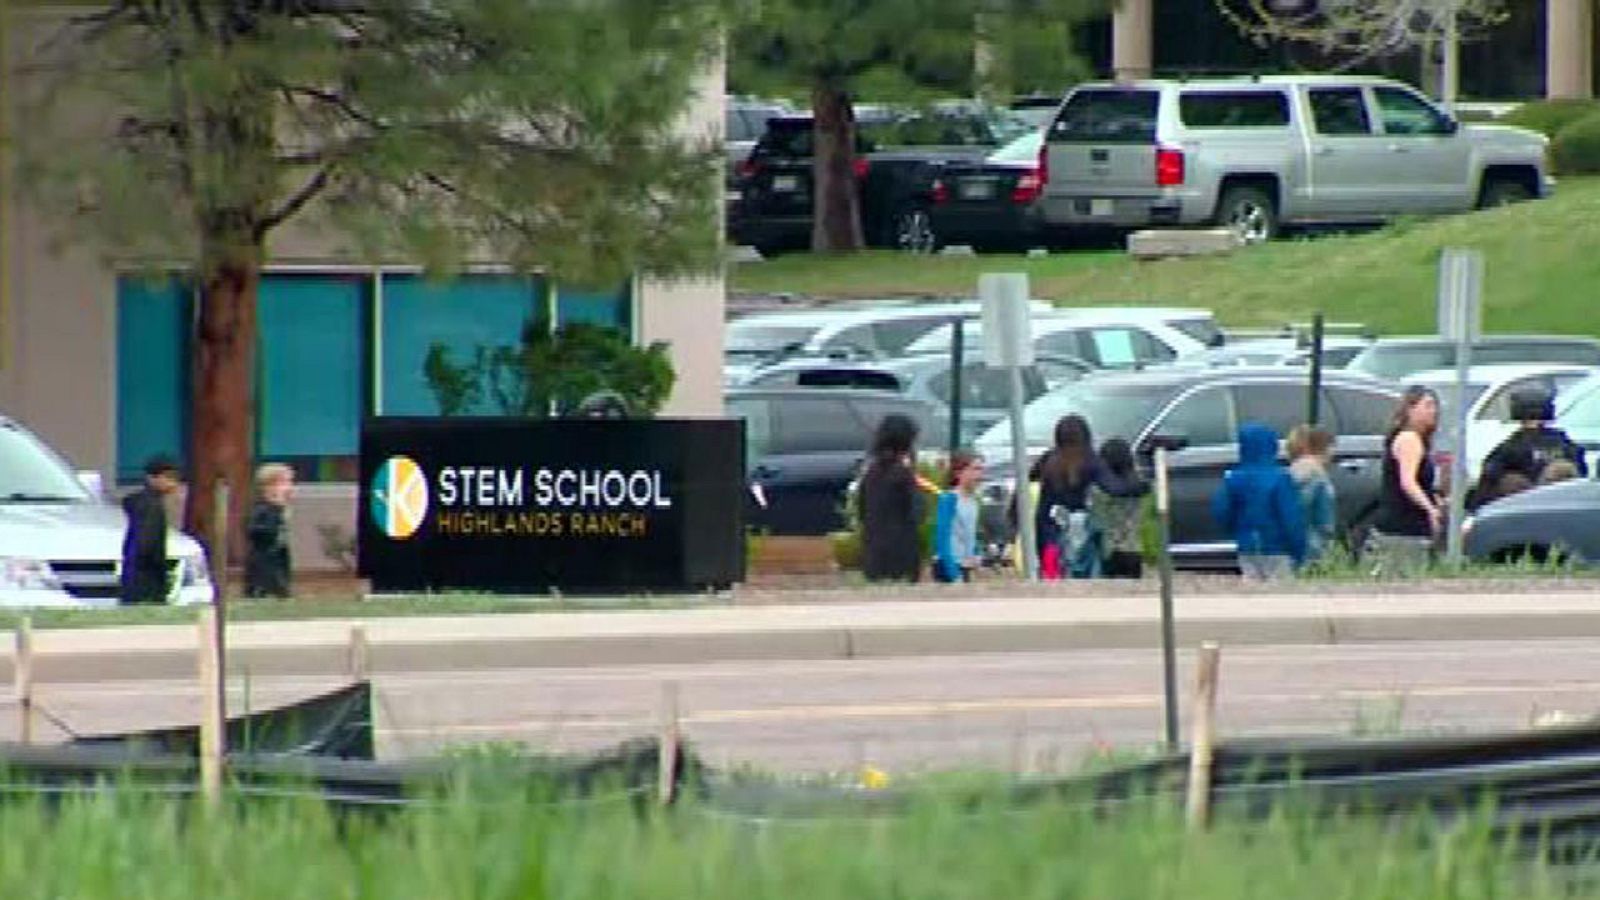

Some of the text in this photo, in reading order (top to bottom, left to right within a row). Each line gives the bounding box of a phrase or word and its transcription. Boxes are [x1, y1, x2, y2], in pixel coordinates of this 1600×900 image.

[438, 467, 671, 507] STEM SCHOOL
[438, 511, 646, 537] HIGHLANDS RANCH
